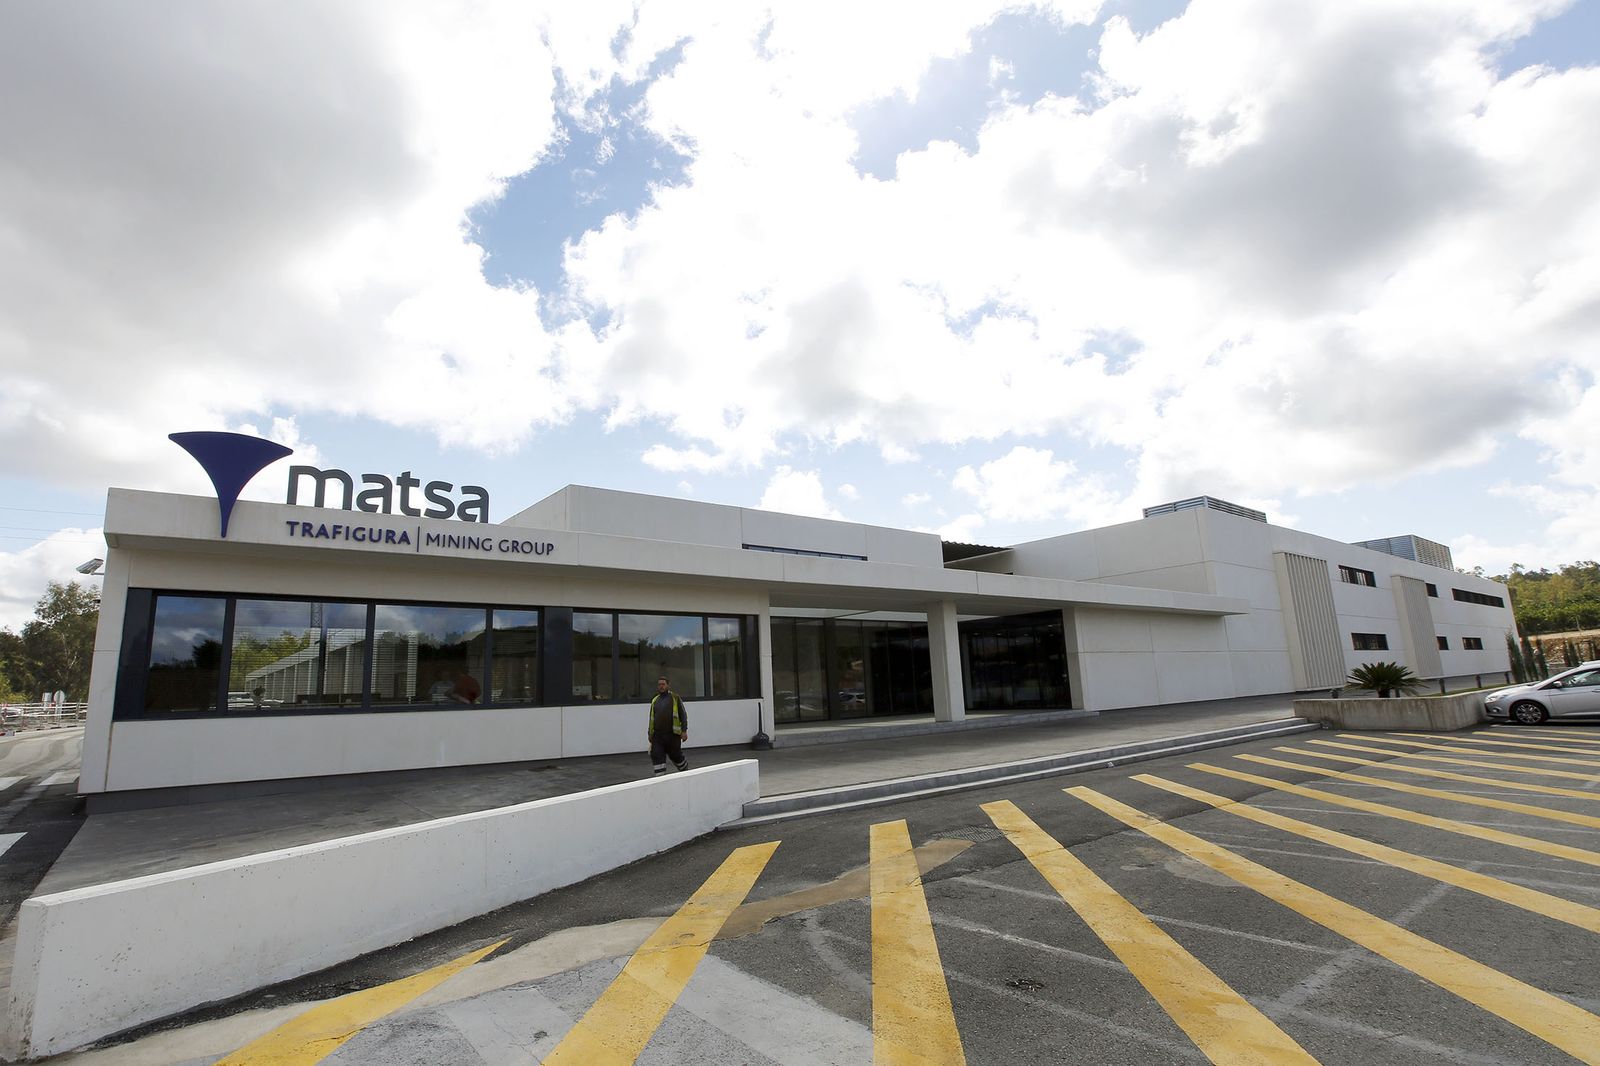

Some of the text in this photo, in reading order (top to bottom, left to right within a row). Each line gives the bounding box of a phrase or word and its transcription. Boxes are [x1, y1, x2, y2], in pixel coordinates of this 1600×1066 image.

[287, 465, 489, 523] matsa
[286, 521, 554, 556] TRAFIGURA MINING GROUP
